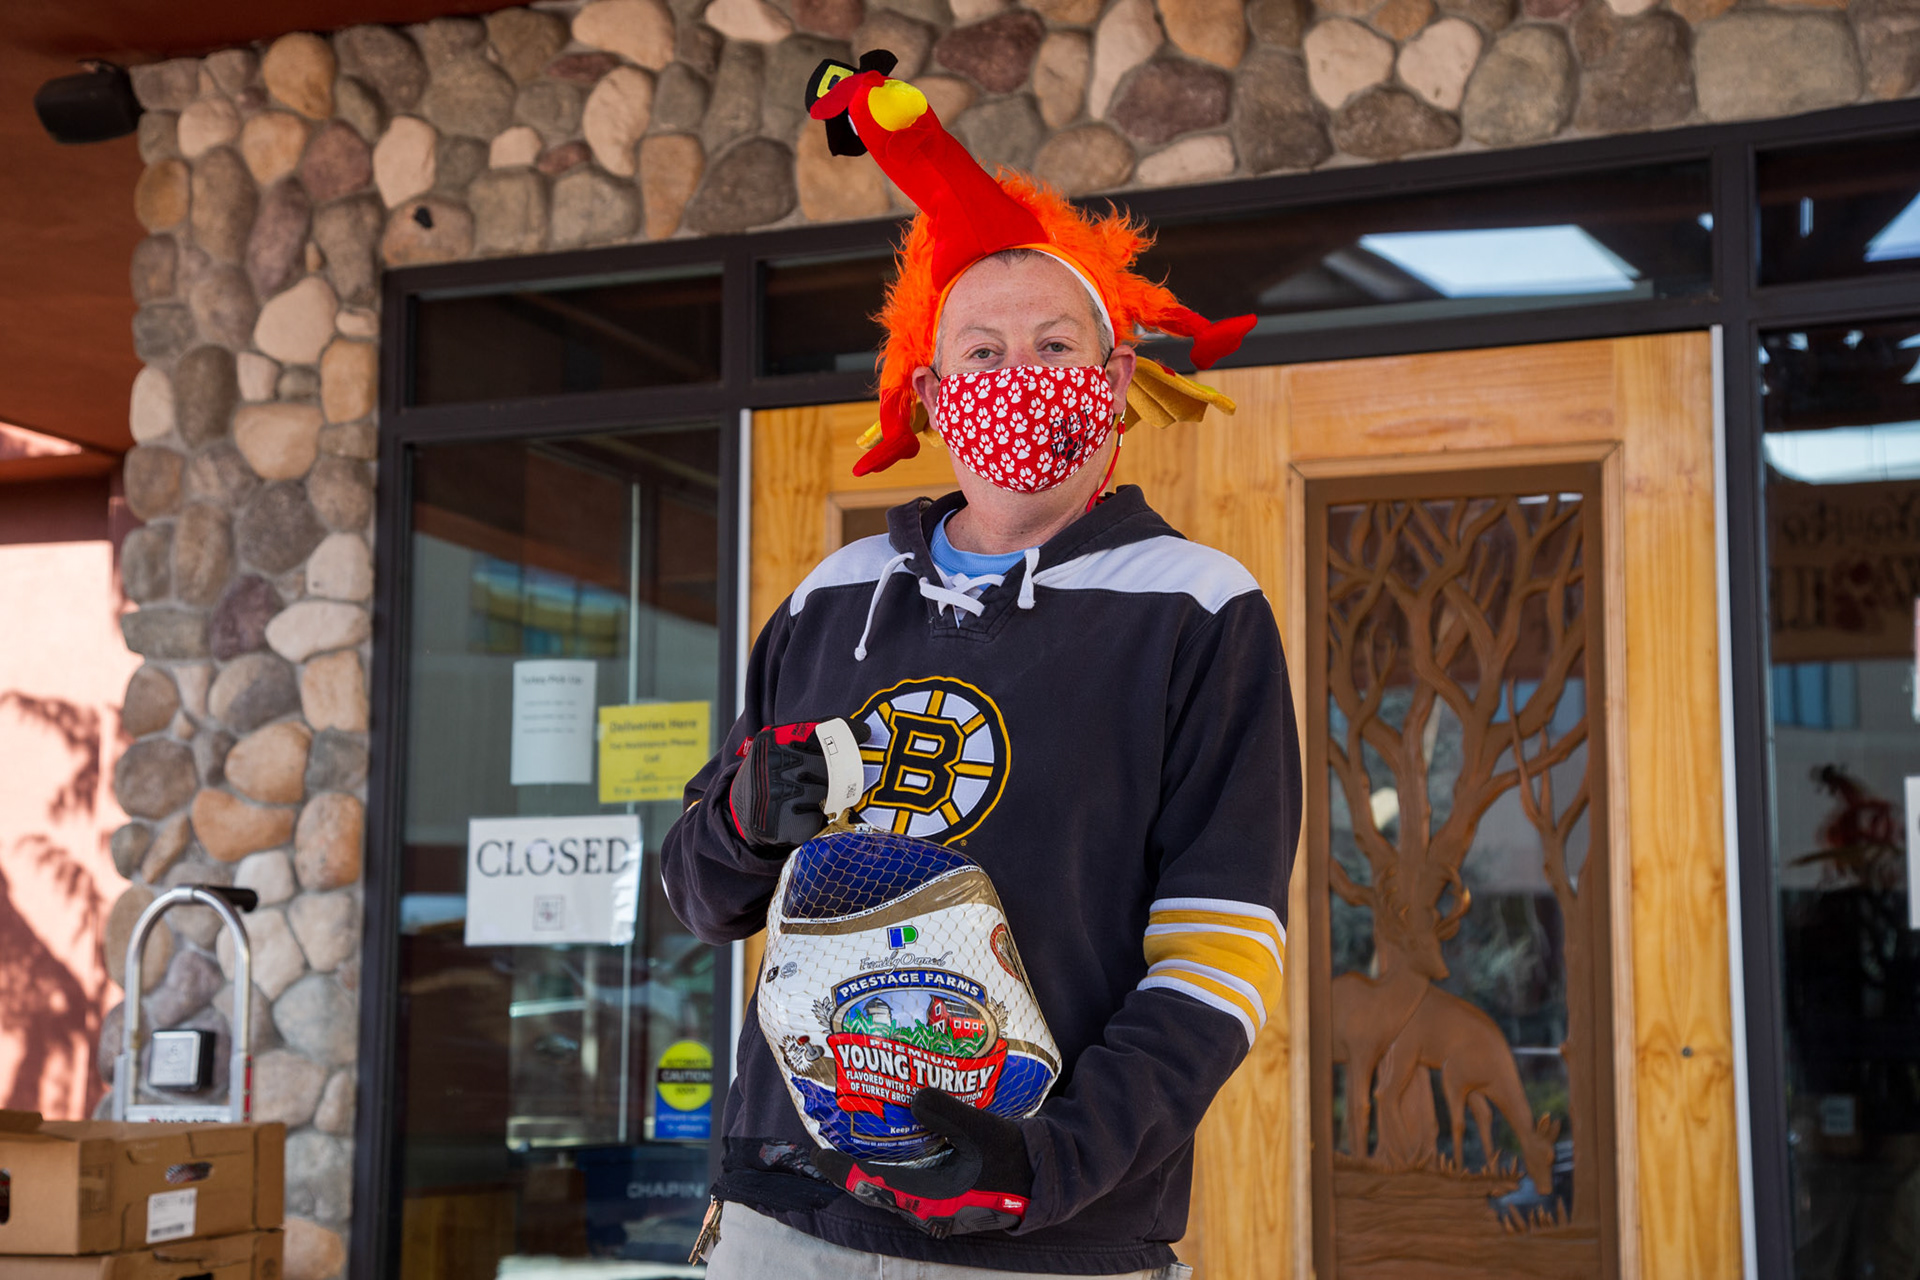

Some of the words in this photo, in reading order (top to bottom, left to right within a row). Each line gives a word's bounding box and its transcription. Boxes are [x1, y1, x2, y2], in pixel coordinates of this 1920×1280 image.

[1050, 408, 1091, 440] GREAT
[610, 720, 666, 733] Deliveries
[669, 719, 698, 729] Here
[476, 836, 631, 878] CLOSED
[860, 950, 899, 975] Family
[901, 951, 953, 967] Owned
[839, 973, 920, 997] PRESTAGE
[925, 973, 980, 997] FARMS
[869, 1039, 958, 1069] PREMIUM
[661, 1070, 713, 1082] CAUTION
[836, 1044, 910, 1081] YOUNG
[913, 1058, 996, 1093] TURKEY
[846, 1071, 884, 1086] FLAVORED
[885, 1078, 904, 1092] WITH
[850, 1082, 860, 1092] OF
[861, 1083, 890, 1099] TURKEY
[890, 1126, 910, 1134] Keep
[627, 1181, 705, 1199] CHAPIN
